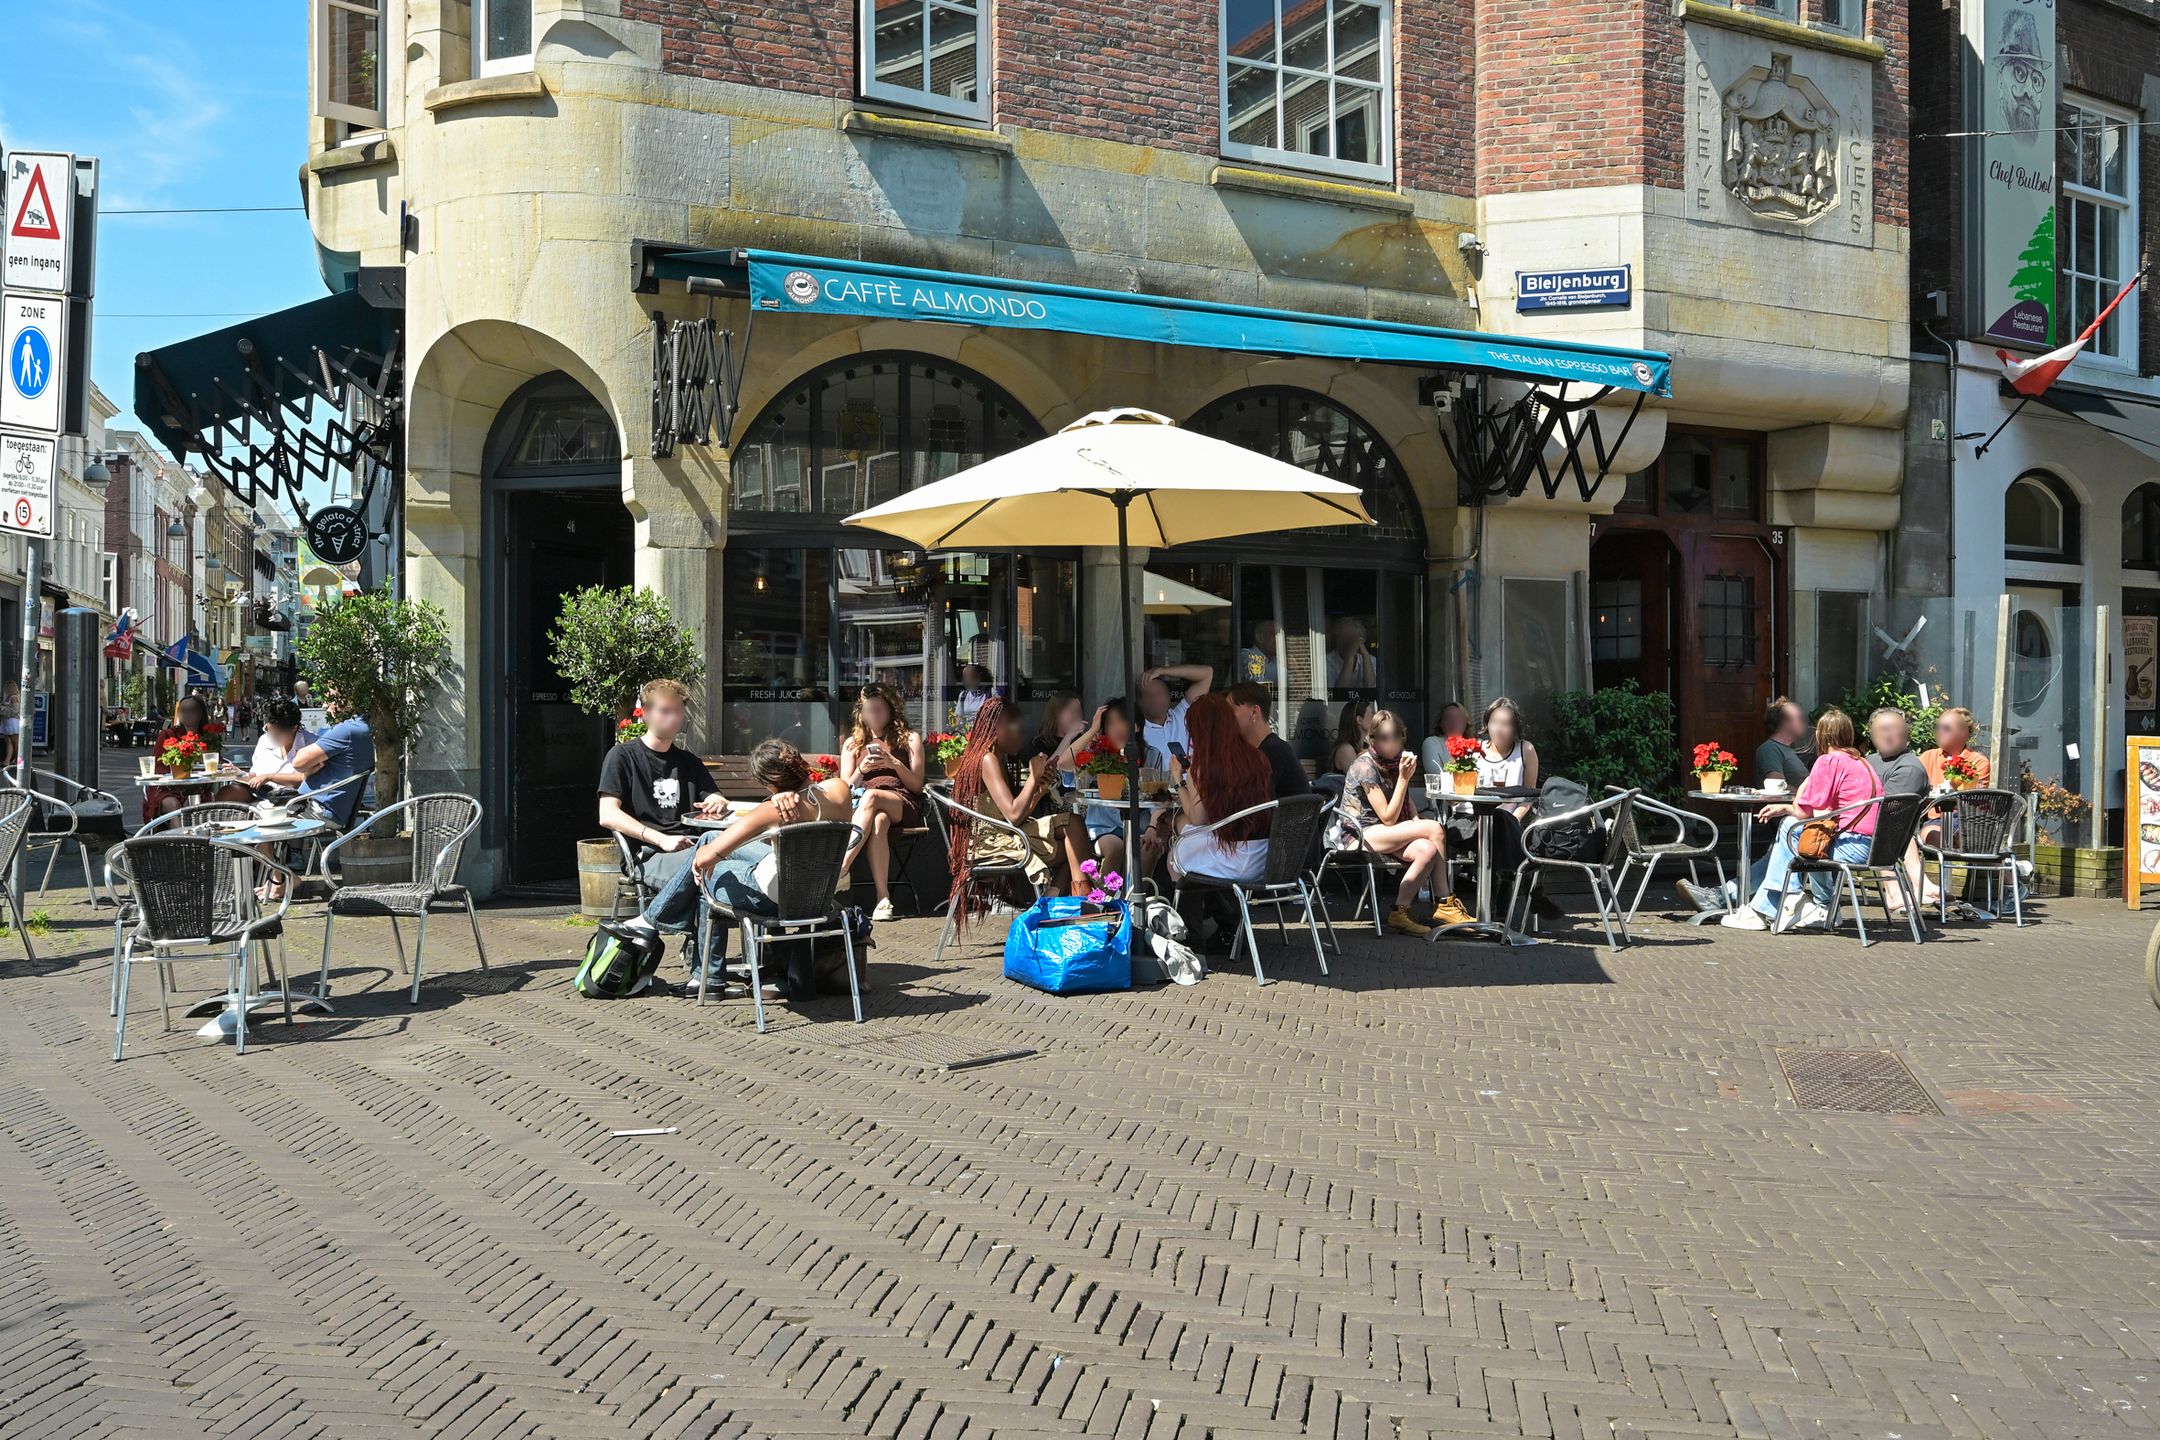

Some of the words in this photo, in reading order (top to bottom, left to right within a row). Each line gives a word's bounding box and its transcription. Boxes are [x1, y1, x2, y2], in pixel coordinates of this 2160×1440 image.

[1989, 160, 2014, 190] Chef
[2016, 166, 2053, 194] Bulbol
[8, 255, 28, 267] geen
[31, 256, 61, 272] ingang
[1526, 274, 1620, 292] Bleijenburg
[824, 279, 906, 306] CAFFÈ
[912, 289, 1046, 319] ALMONDO
[20, 306, 46, 319] ZONE
[2014, 309, 2043, 323] Lebanese
[2012, 319, 2044, 333] Restaurant
[1487, 351, 1510, 361] THE
[1512, 353, 1553, 368] ITALIAN
[1555, 359, 1608, 374] ESPRESSO
[1609, 364, 1632, 377] BAR
[6, 439, 47, 453] toegestaan:
[19, 506, 28, 518] 15
[316, 512, 345, 531] gelato
[567, 520, 576, 534] 46
[1772, 530, 1783, 544] 35
[2126, 637, 2149, 646] LEBANESE
[532, 692, 558, 701] ESPRESSO
[750, 690, 775, 699] FRESH
[778, 690, 801, 699] JUICE
[1347, 691, 1360, 699] TEA
[1287, 728, 1339, 741] LMONDO
